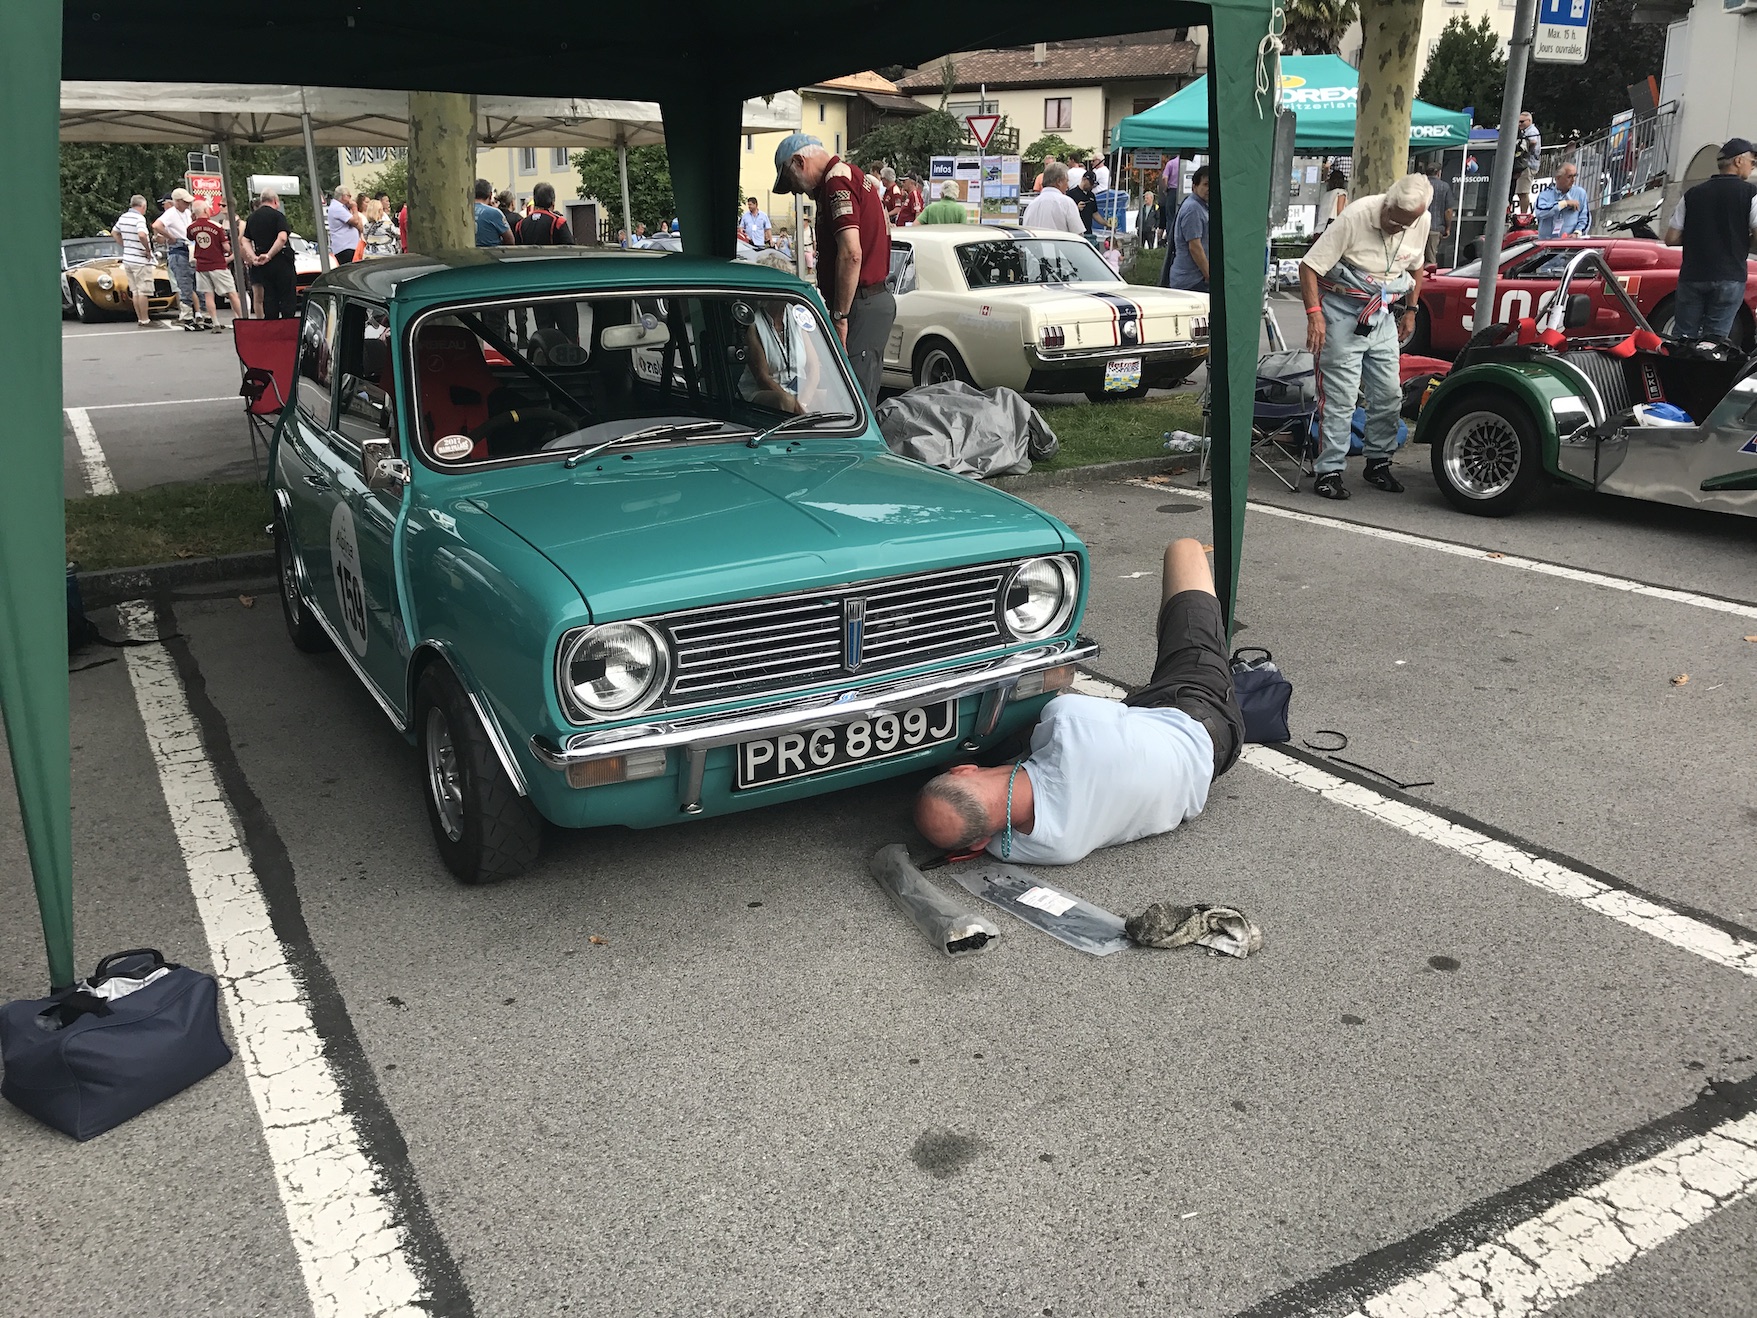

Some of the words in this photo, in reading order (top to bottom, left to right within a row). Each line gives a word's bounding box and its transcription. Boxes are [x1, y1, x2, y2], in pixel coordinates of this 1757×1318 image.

[1547, 28, 1561, 39] Max.
[1564, 29, 1570, 39] 15
[1555, 44, 1582, 55] ouvrables
[1275, 86, 1359, 103] OREX
[336, 560, 367, 641] 159
[746, 727, 836, 781] PRG
[845, 698, 954, 758] 899J
